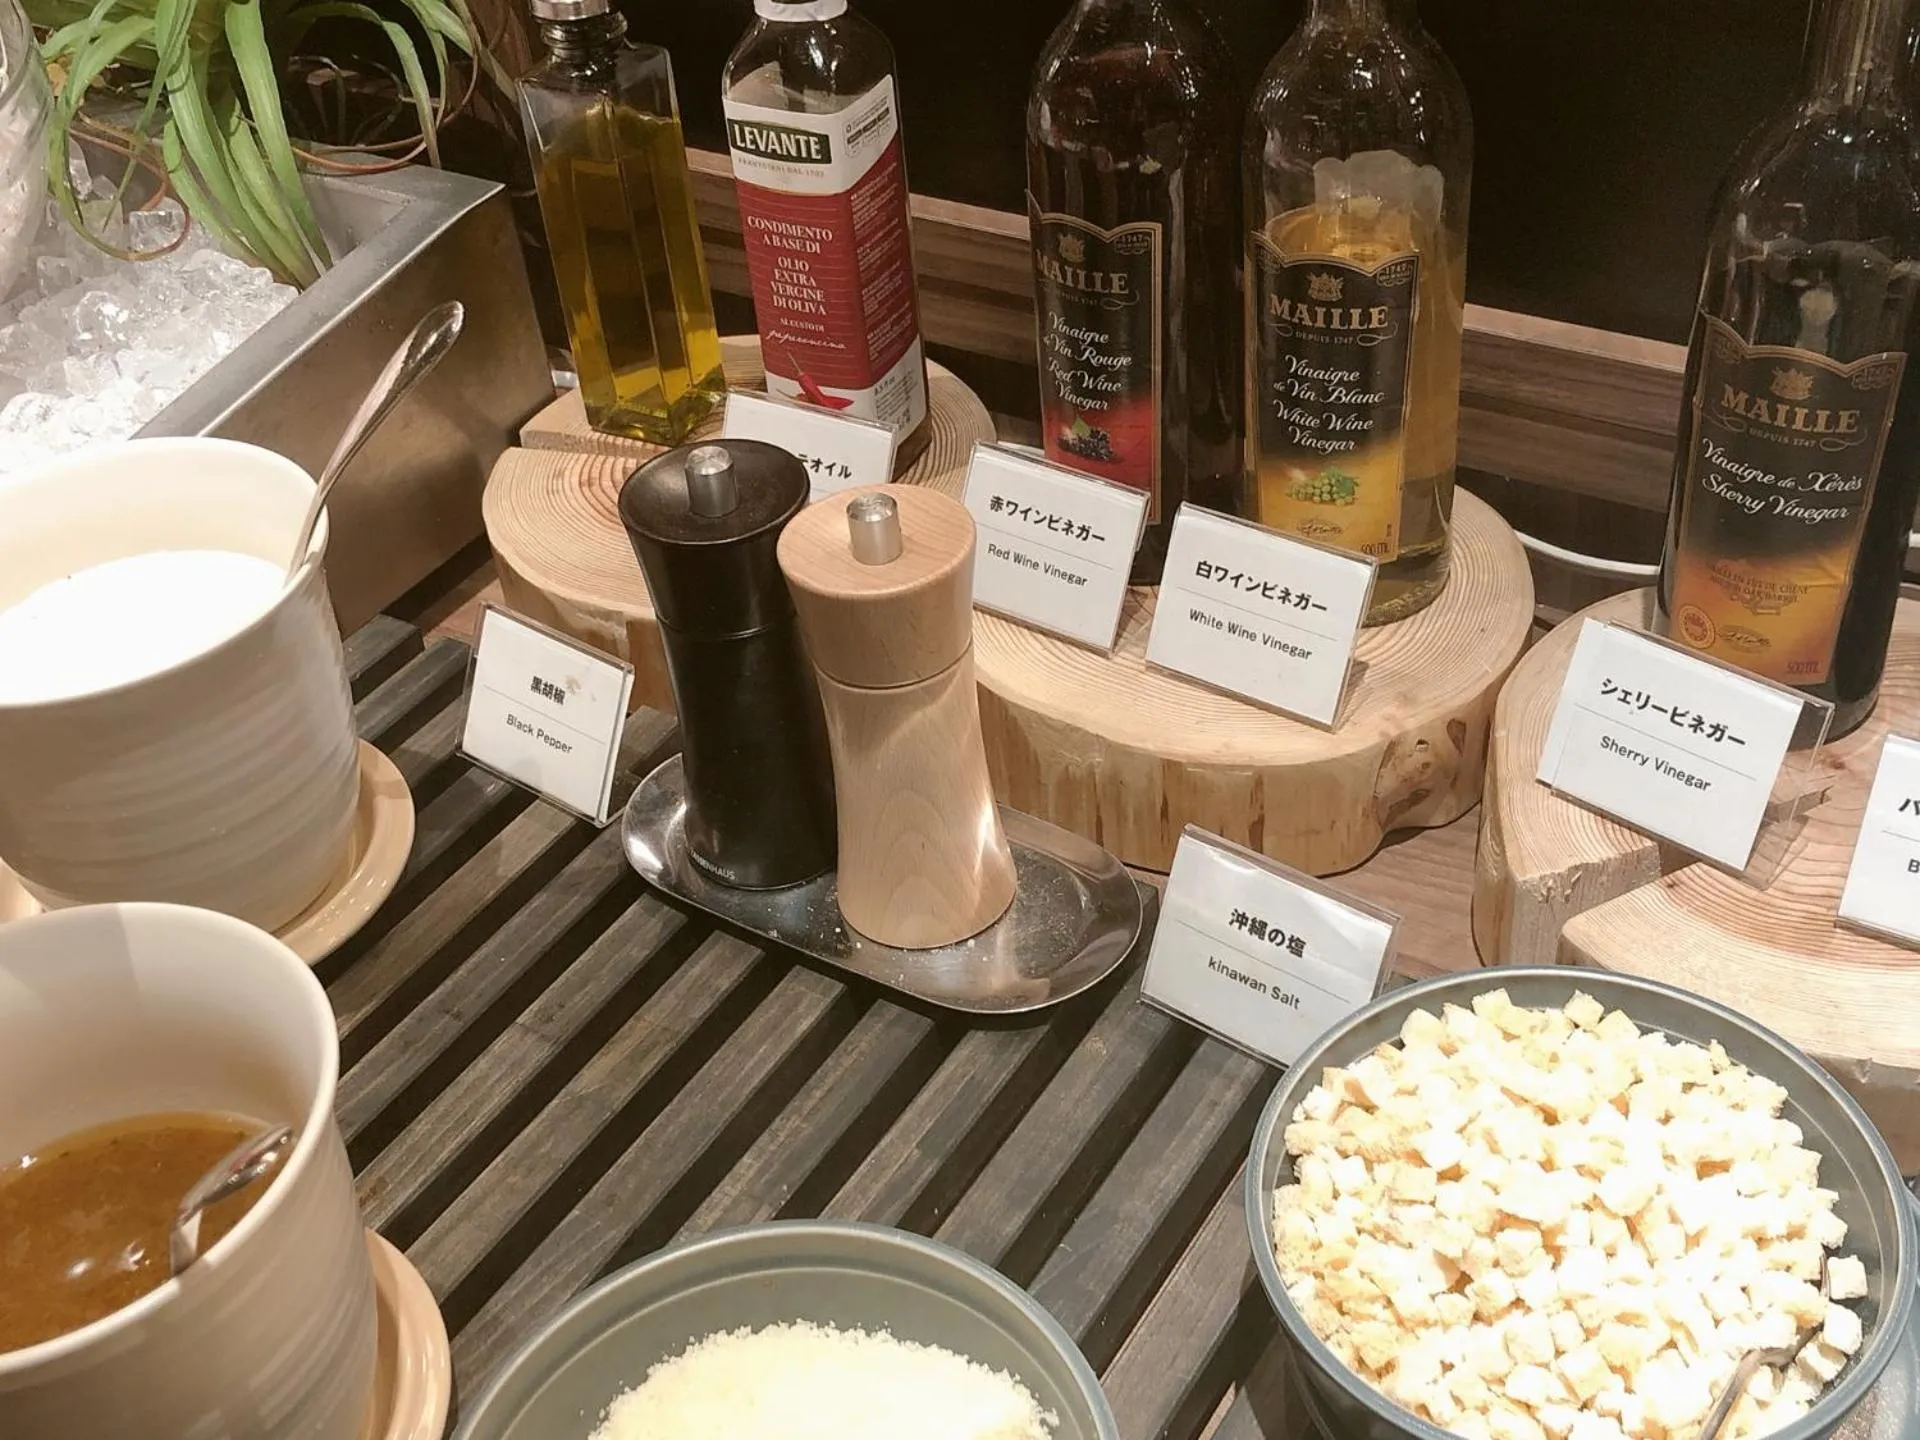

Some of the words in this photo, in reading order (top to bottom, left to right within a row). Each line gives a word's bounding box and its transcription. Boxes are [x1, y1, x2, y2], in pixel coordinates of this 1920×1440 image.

[733, 124, 822, 160] LEVANTE
[747, 215, 834, 241] CONDIMENTO
[762, 233, 772, 245] A
[772, 234, 805, 252] BASE
[805, 240, 821, 254] DI
[774, 268, 817, 288] EXTRA
[777, 256, 810, 273] OLIO
[1036, 248, 1129, 295] MAILLE
[772, 295, 787, 309] DI
[787, 298, 827, 316] OLIVA
[1269, 293, 1389, 330] MAILLE
[1048, 311, 1109, 346] Vinaigre
[1050, 333, 1073, 358] Vin
[1075, 344, 1133, 372] Rouge
[1285, 354, 1361, 387] Vinaigre
[1049, 356, 1073, 383] Red
[1077, 370, 1122, 393] Wine
[1286, 378, 1318, 402] Vin
[1319, 385, 1385, 405] Blanc
[1055, 379, 1109, 411] Vinegar
[1720, 383, 1861, 434] MAILLE
[1273, 399, 1321, 429] White
[1322, 411, 1375, 432] Wine
[1288, 425, 1357, 455] Vinegar
[1701, 437, 1776, 485] Vinaigre
[1702, 472, 1768, 515] Sherry
[1768, 494, 1851, 525] Vinegar
[1777, 476, 1796, 489] de
[989, 494, 1106, 543] 赤ワインビネガー
[987, 543, 1011, 562] Red
[1013, 551, 1041, 571] Wine
[1043, 562, 1089, 588] Vinegar
[1195, 559, 1329, 613] 白ワインビネガー
[1189, 607, 1224, 631] White
[1227, 620, 1258, 642] Wine
[1262, 632, 1313, 661] Vinegar
[530, 675, 567, 706] 黒胡椒
[1600, 677, 1747, 748] シェリービネガー
[506, 713, 535, 738] Black
[536, 727, 573, 755] Pepper
[1600, 734, 1650, 767] Sherry
[1653, 756, 1712, 792] Vinegar
[1228, 907, 1308, 959] 沖縄の塩
[1207, 954, 1268, 995] kinawan
[1271, 985, 1302, 1011] Salt
